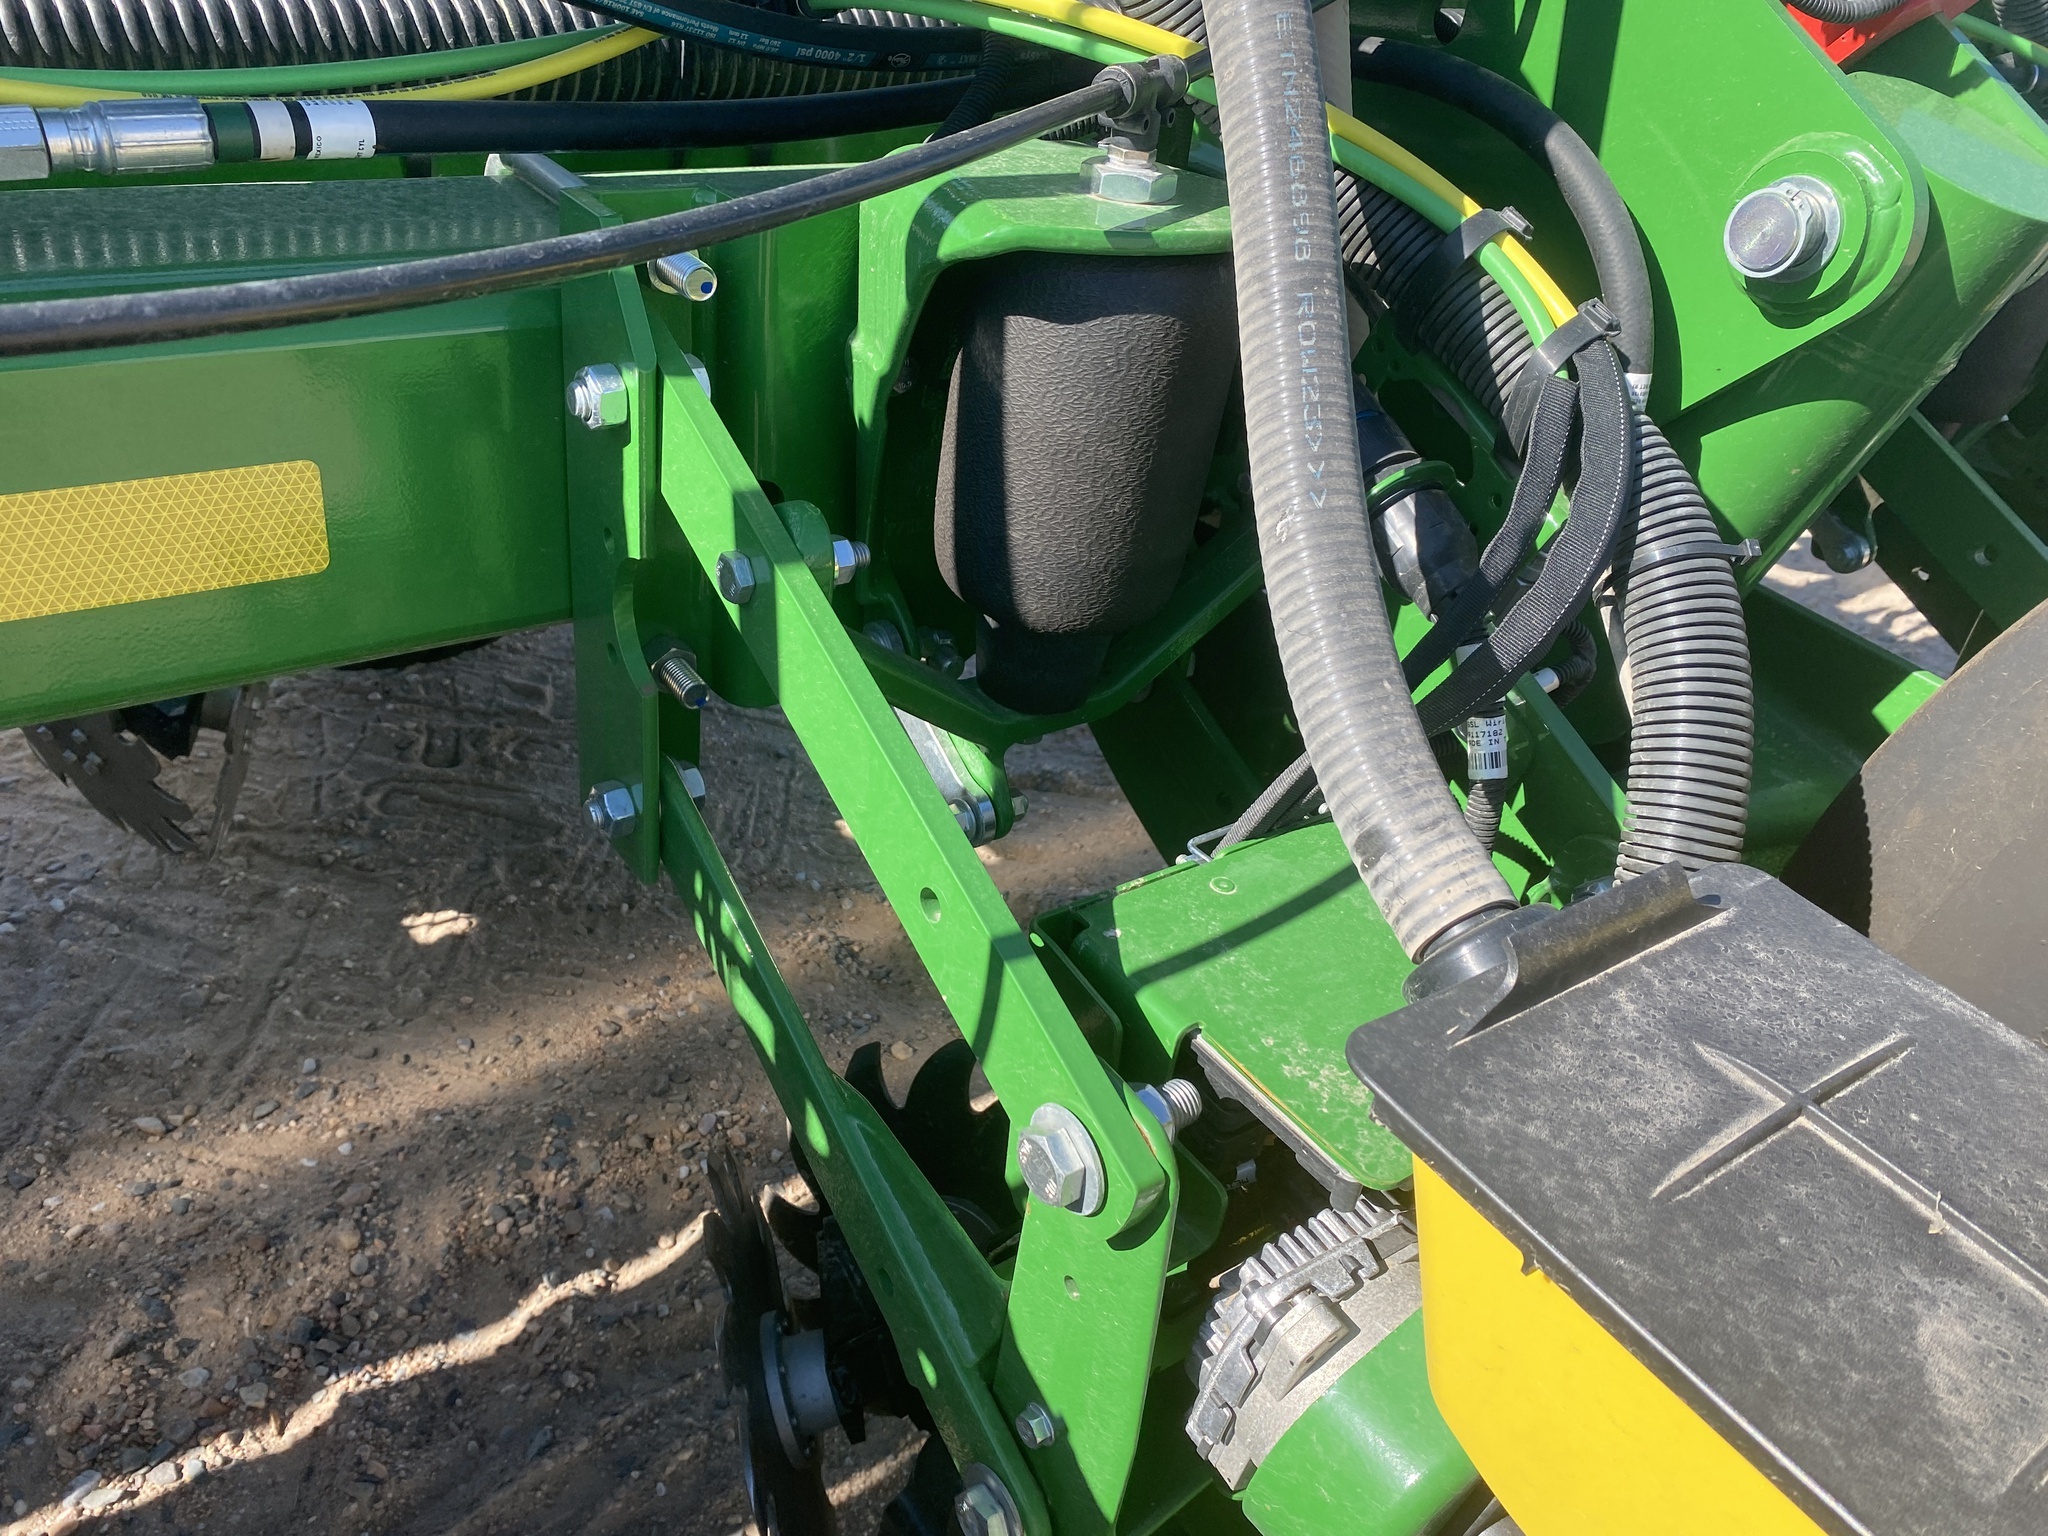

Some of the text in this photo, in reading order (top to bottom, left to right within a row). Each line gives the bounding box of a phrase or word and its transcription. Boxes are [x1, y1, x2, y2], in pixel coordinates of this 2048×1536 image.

[631, 7, 645, 18] SAE
[652, 6, 661, 15] of
[661, 9, 700, 28] Performance
[700, 20, 719, 33] Meets
[795, 47, 814, 57] psi
[814, 49, 842, 60] 4000
[1488, 738, 1500, 746] IN
